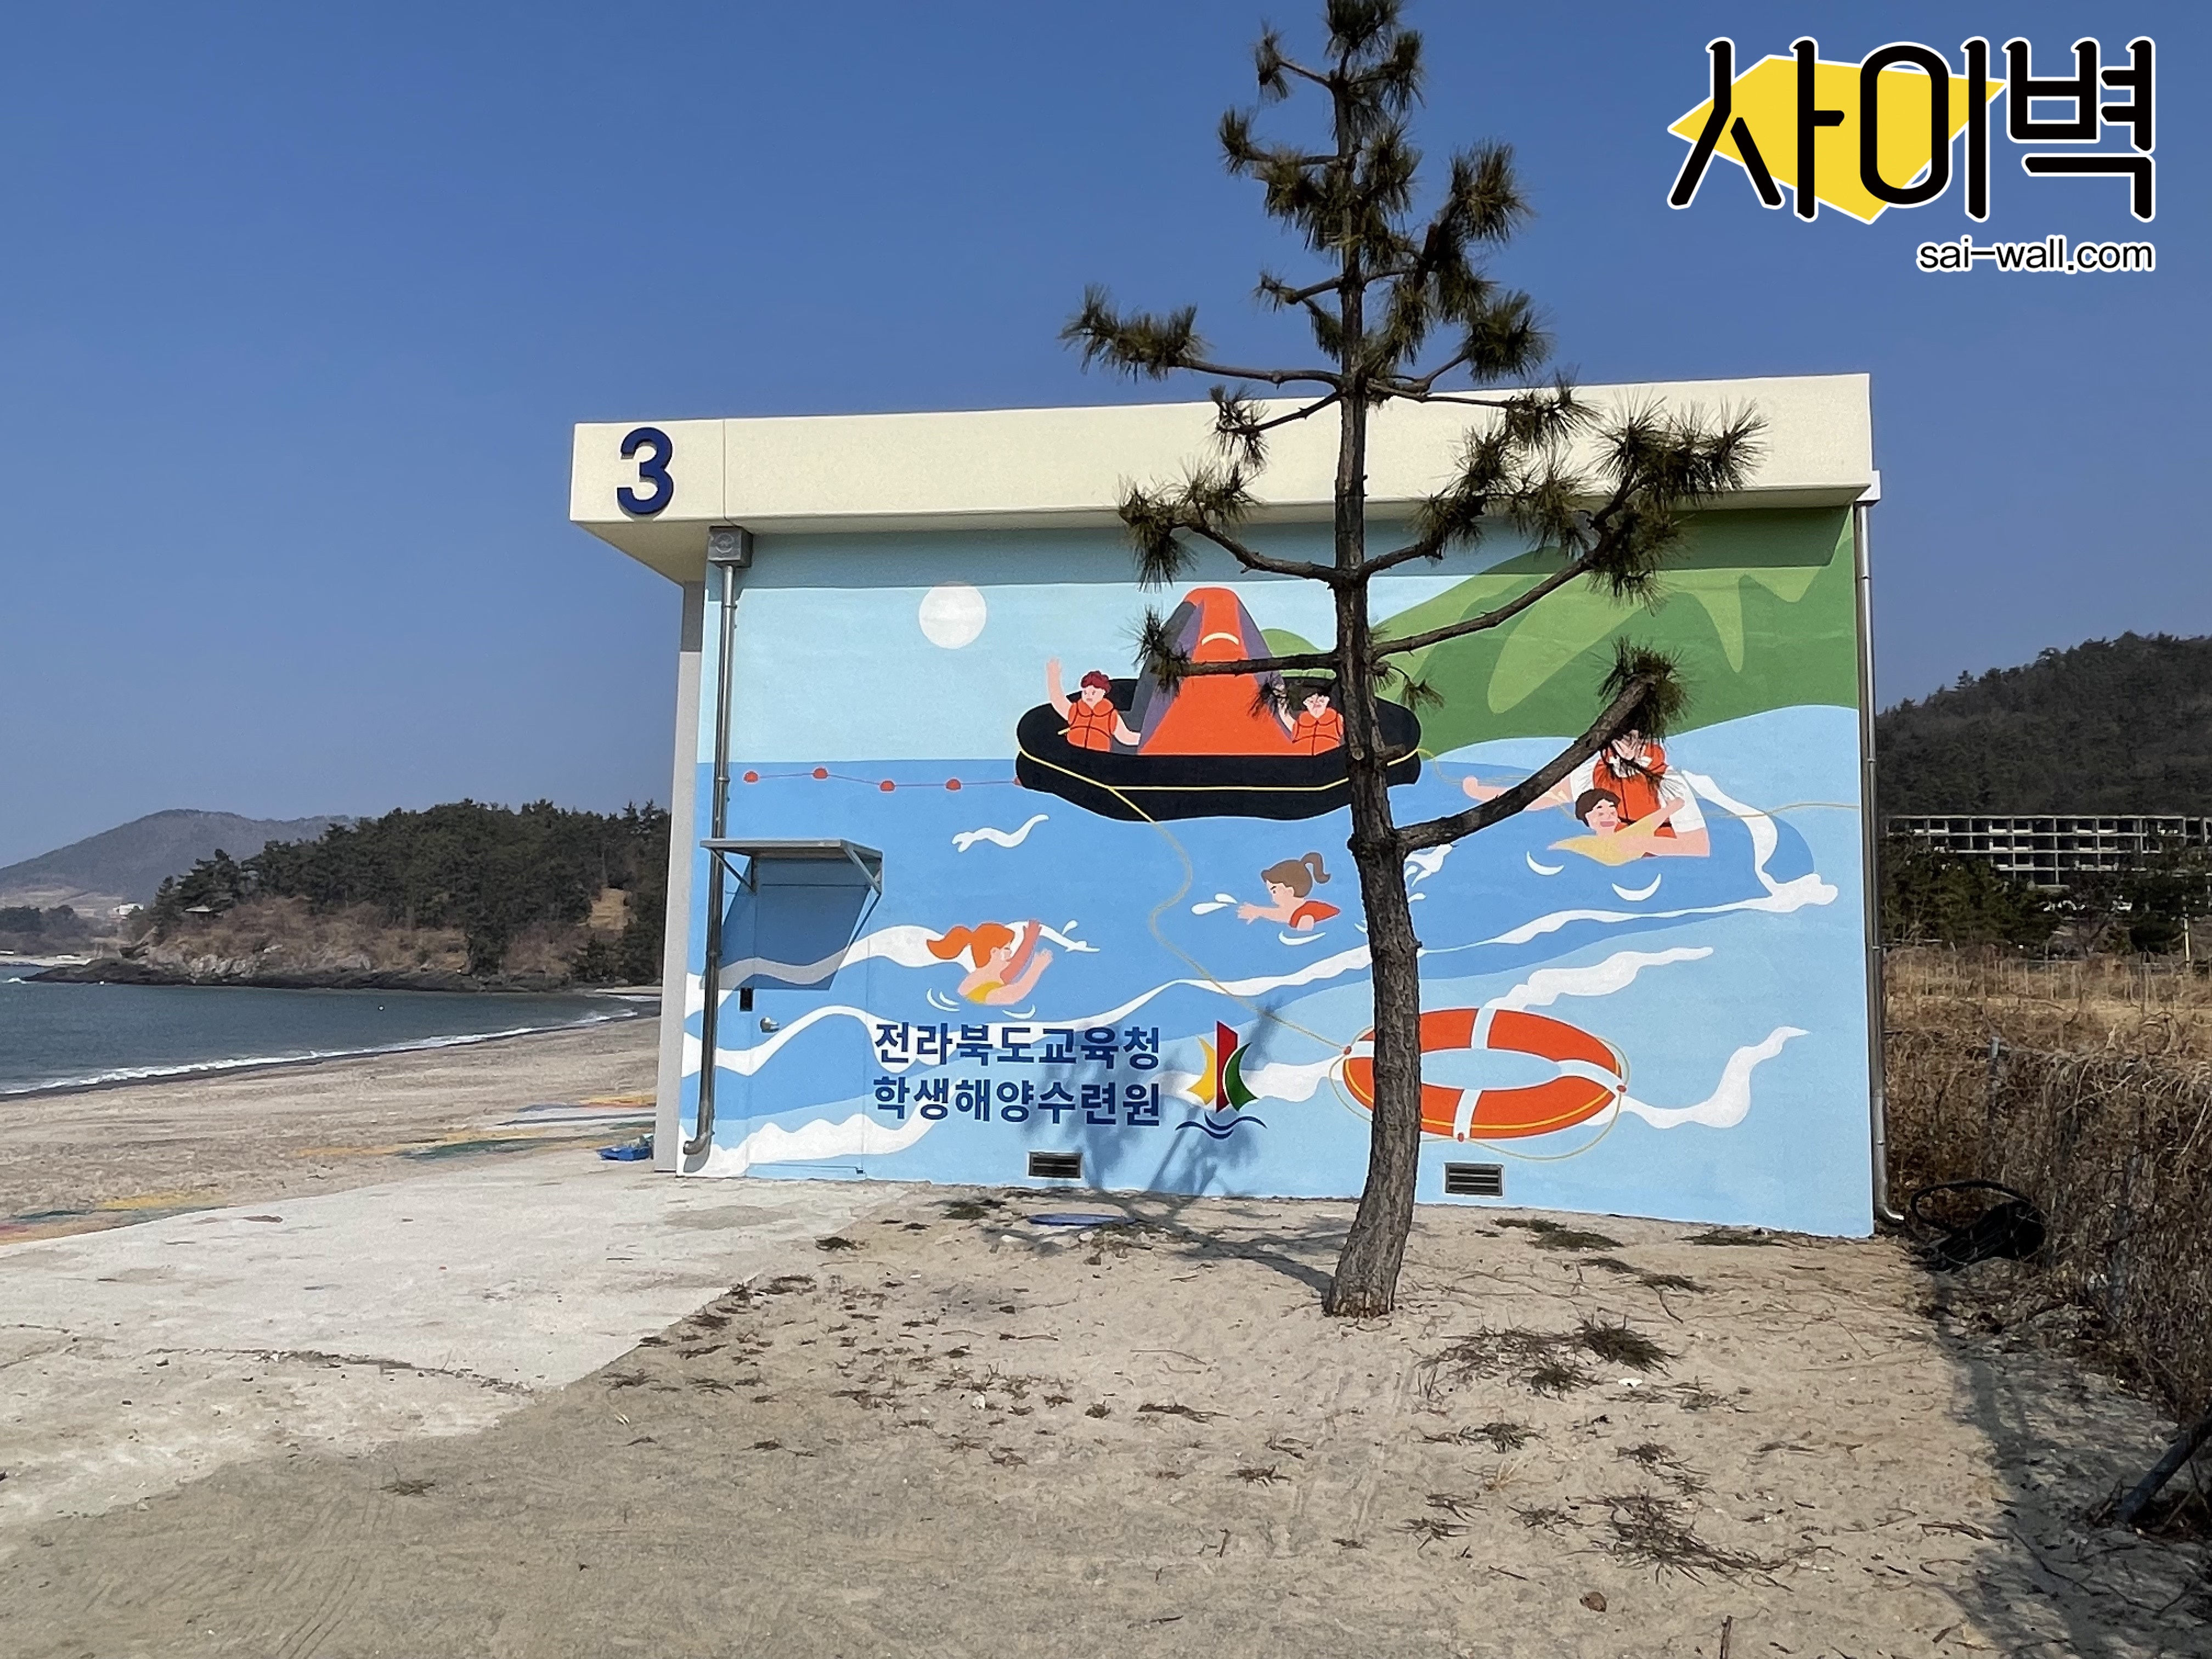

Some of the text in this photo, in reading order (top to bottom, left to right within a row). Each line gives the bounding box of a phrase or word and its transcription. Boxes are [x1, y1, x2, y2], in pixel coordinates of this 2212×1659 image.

[617, 427, 674, 515] 3
[874, 1022, 1160, 1070] 전라북도교육청
[872, 1075, 1160, 1127] 학생해양수련원
